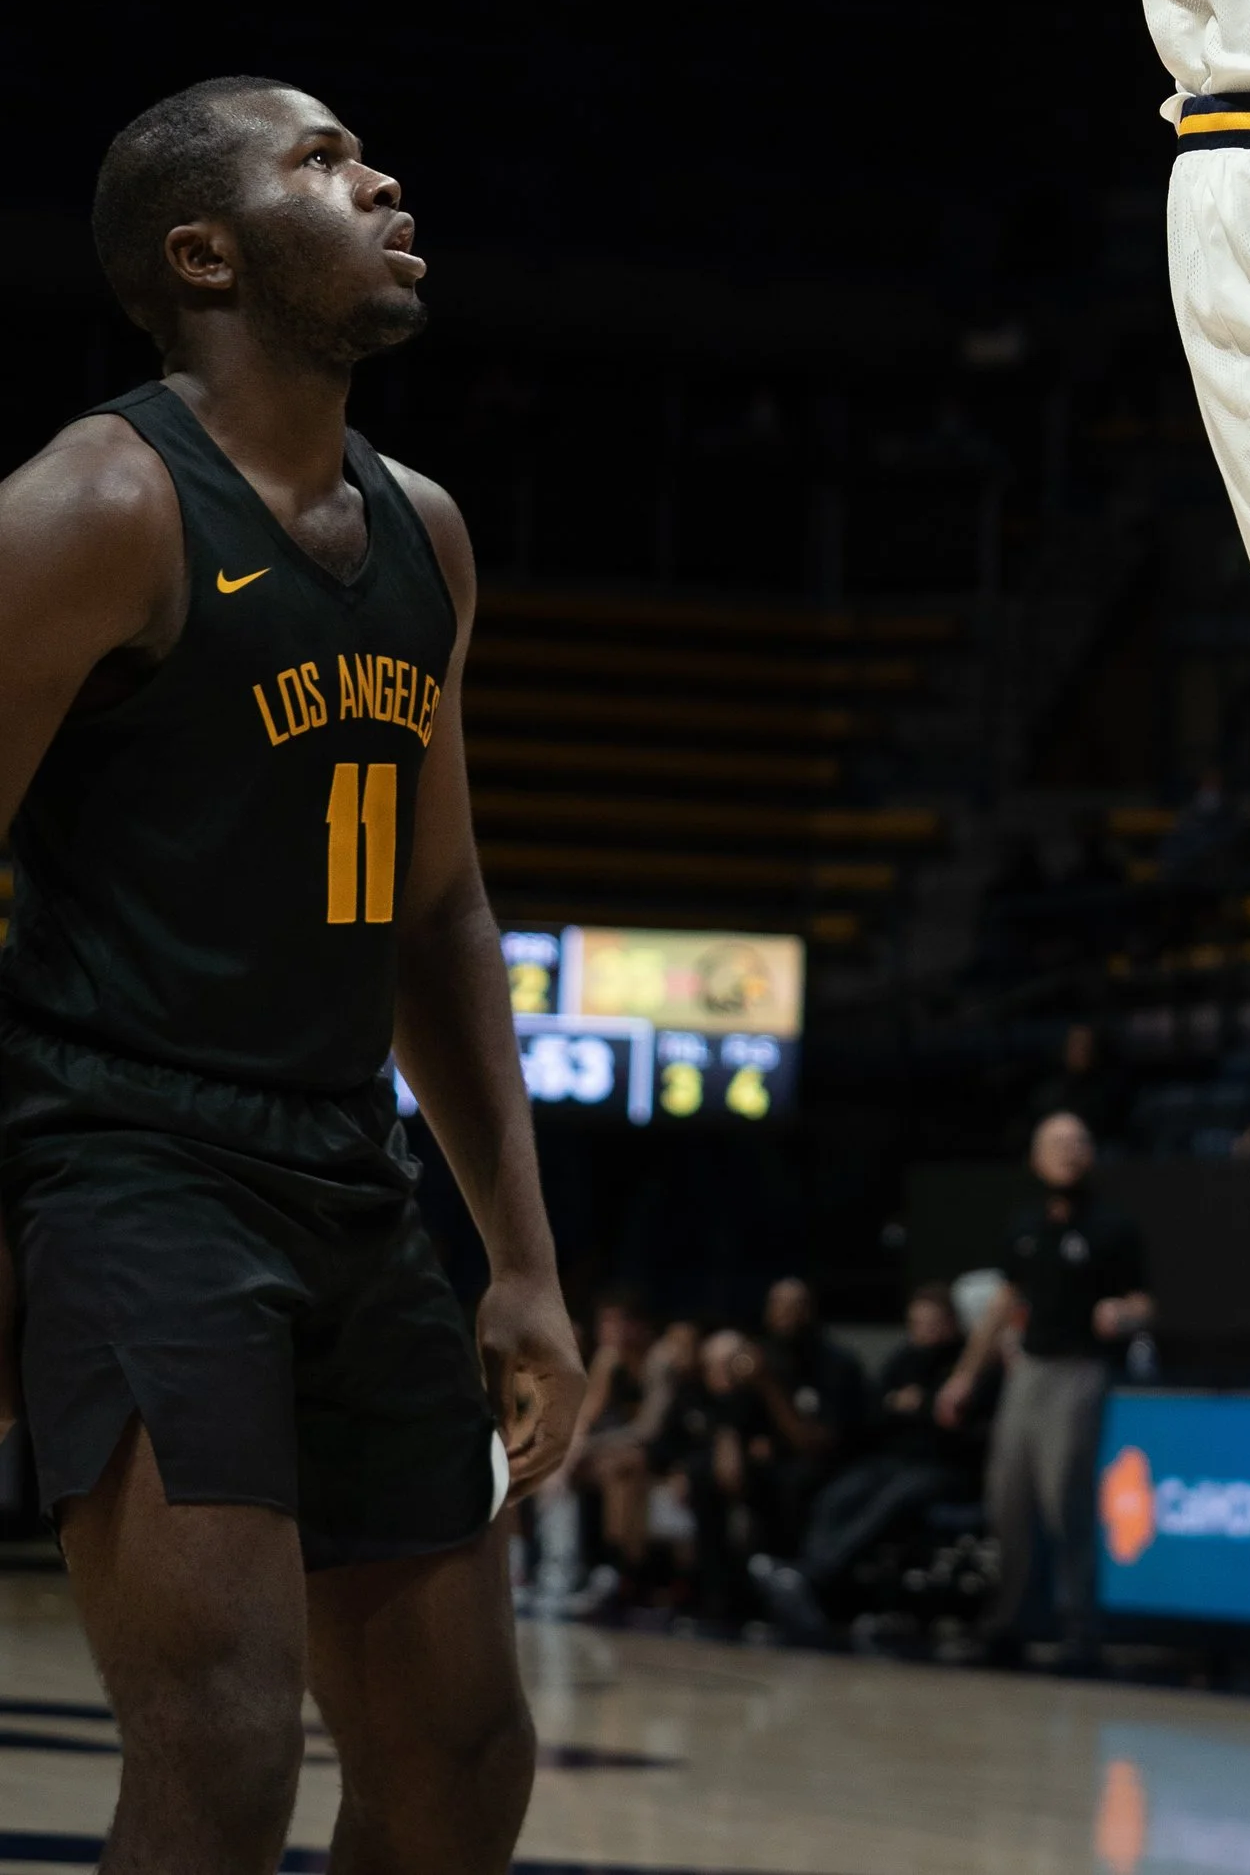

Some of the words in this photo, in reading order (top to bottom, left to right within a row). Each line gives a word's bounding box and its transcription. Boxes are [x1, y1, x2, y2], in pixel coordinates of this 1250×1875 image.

[253, 661, 327, 747] LOS
[338, 653, 440, 748] ANGELES
[325, 762, 397, 924] 11
